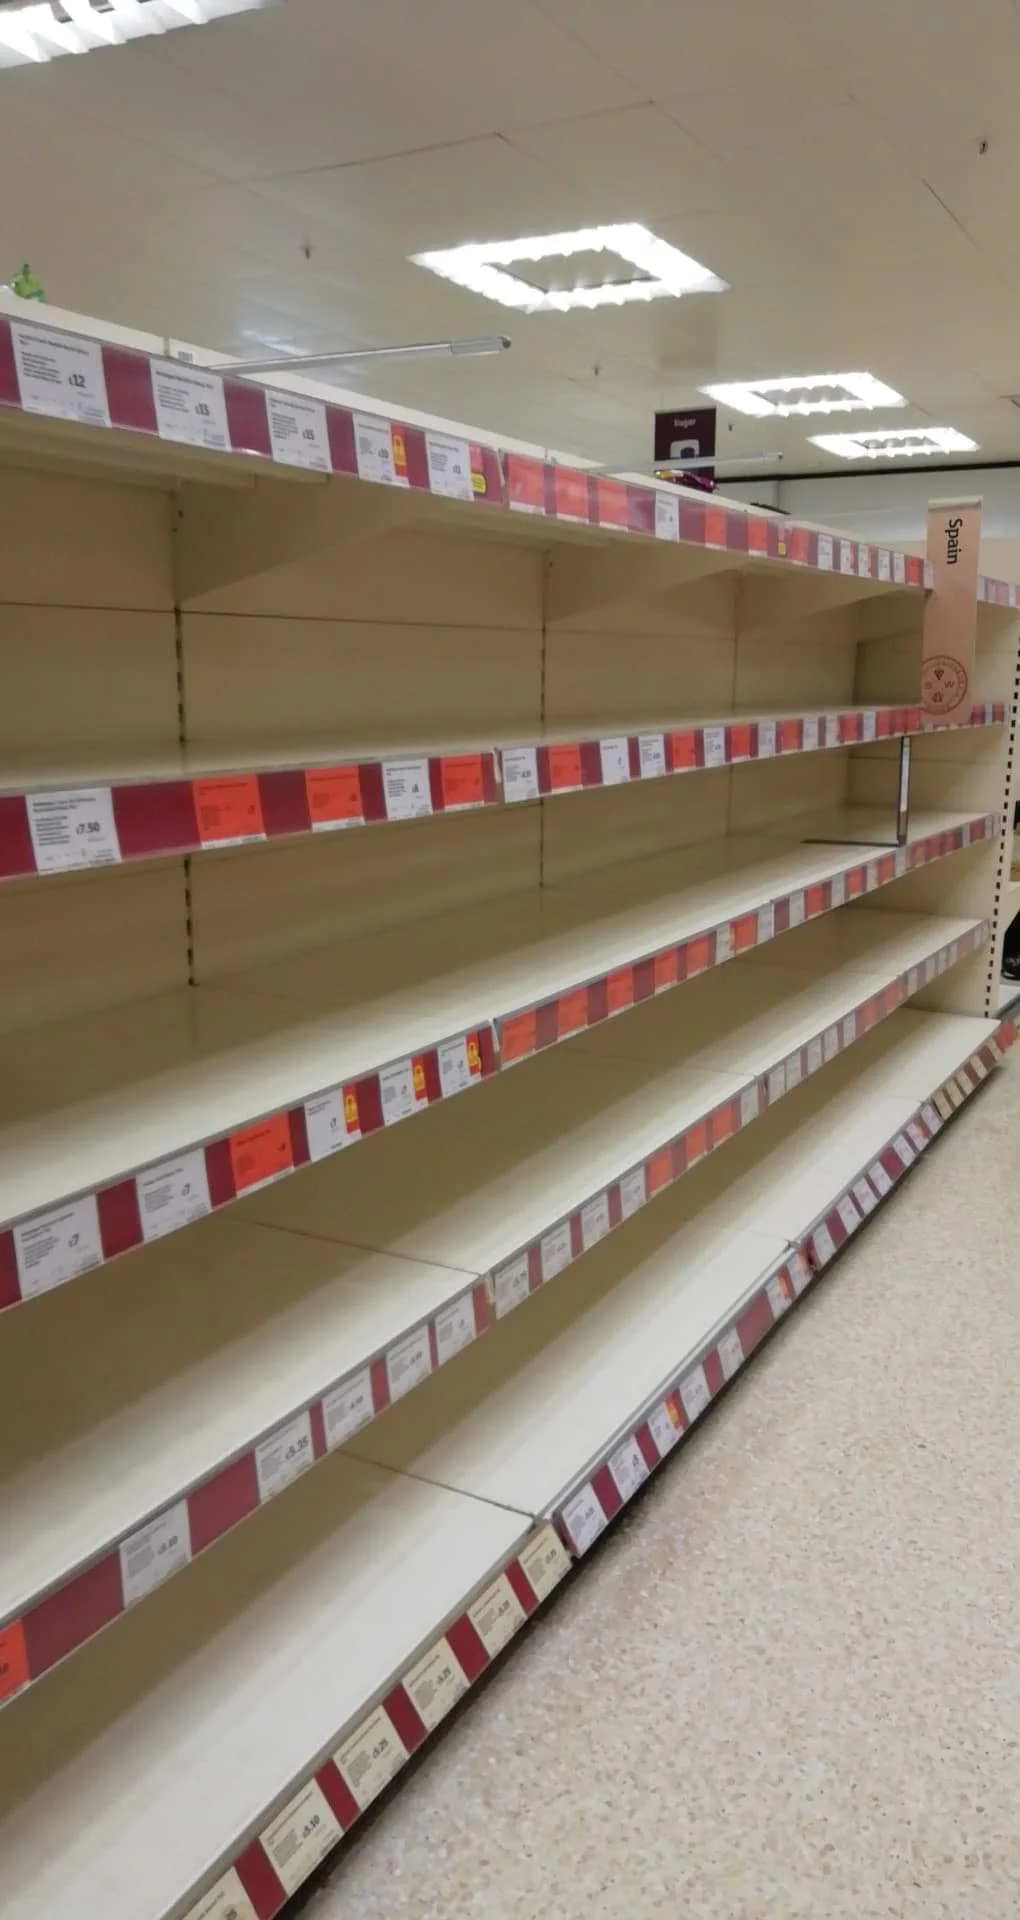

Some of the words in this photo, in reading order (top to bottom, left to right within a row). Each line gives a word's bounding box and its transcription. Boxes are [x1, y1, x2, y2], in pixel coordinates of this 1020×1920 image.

[674, 417, 697, 430] Sugar
[944, 518, 963, 566] Spain
[75, 821, 101, 835] £7.50
